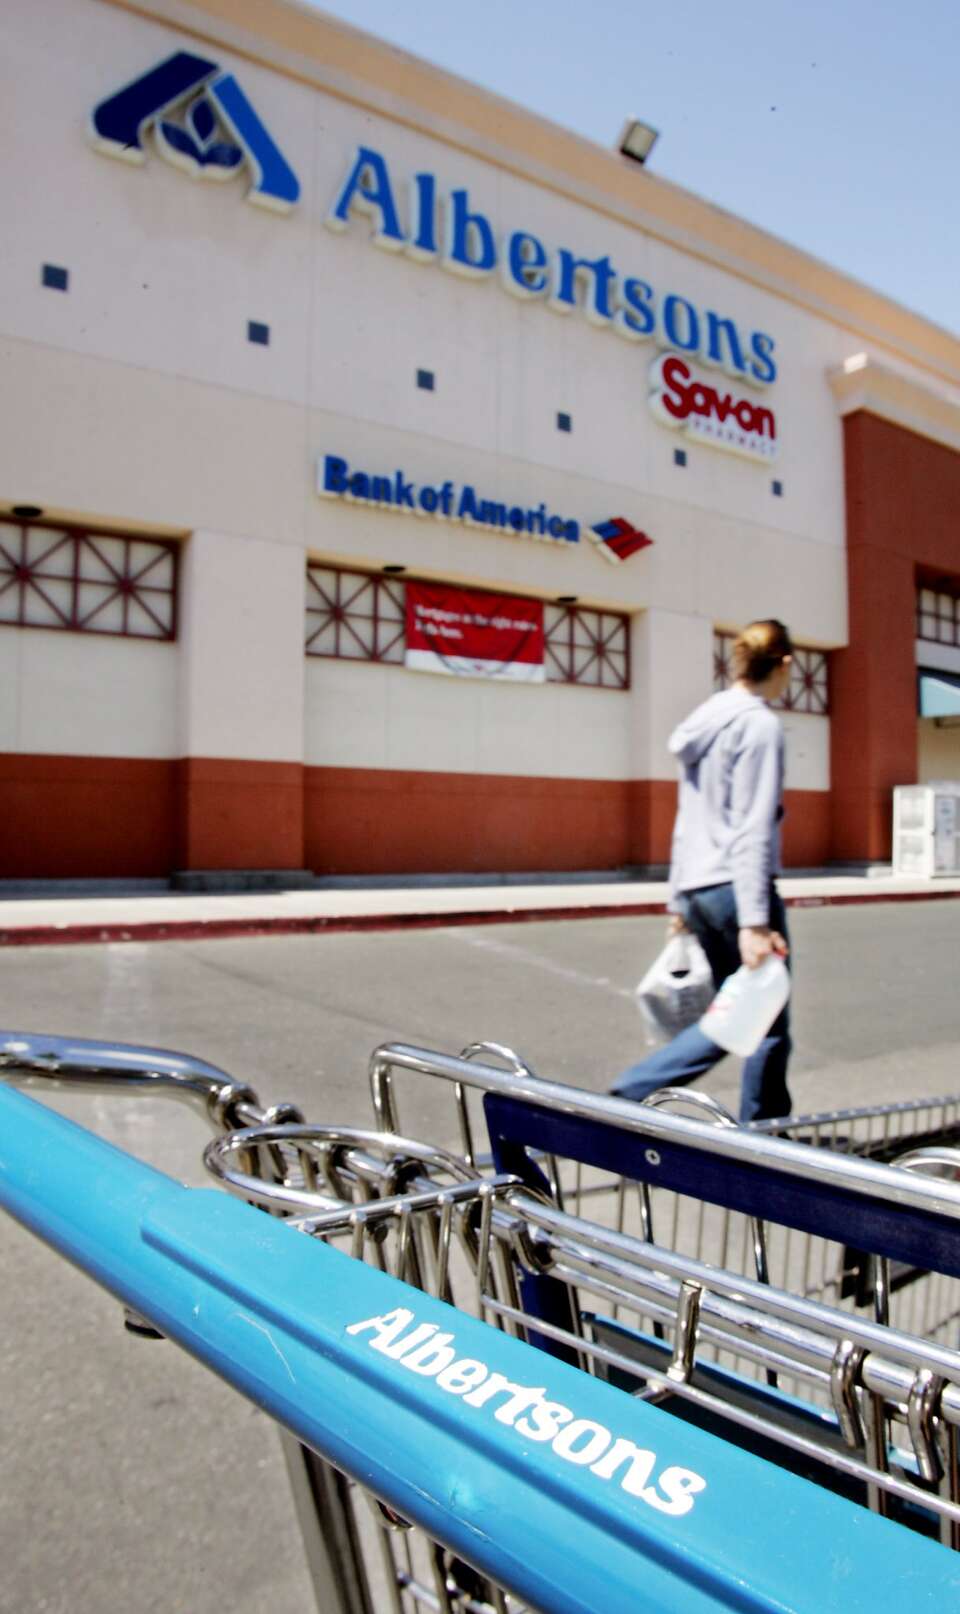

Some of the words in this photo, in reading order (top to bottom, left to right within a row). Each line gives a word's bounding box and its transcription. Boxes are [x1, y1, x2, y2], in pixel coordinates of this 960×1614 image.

[332, 146, 777, 384] Albertsons
[323, 454, 415, 508] Bank
[418, 481, 454, 515] of
[458, 486, 581, 543] America
[346, 1307, 706, 1516] Albertsons
